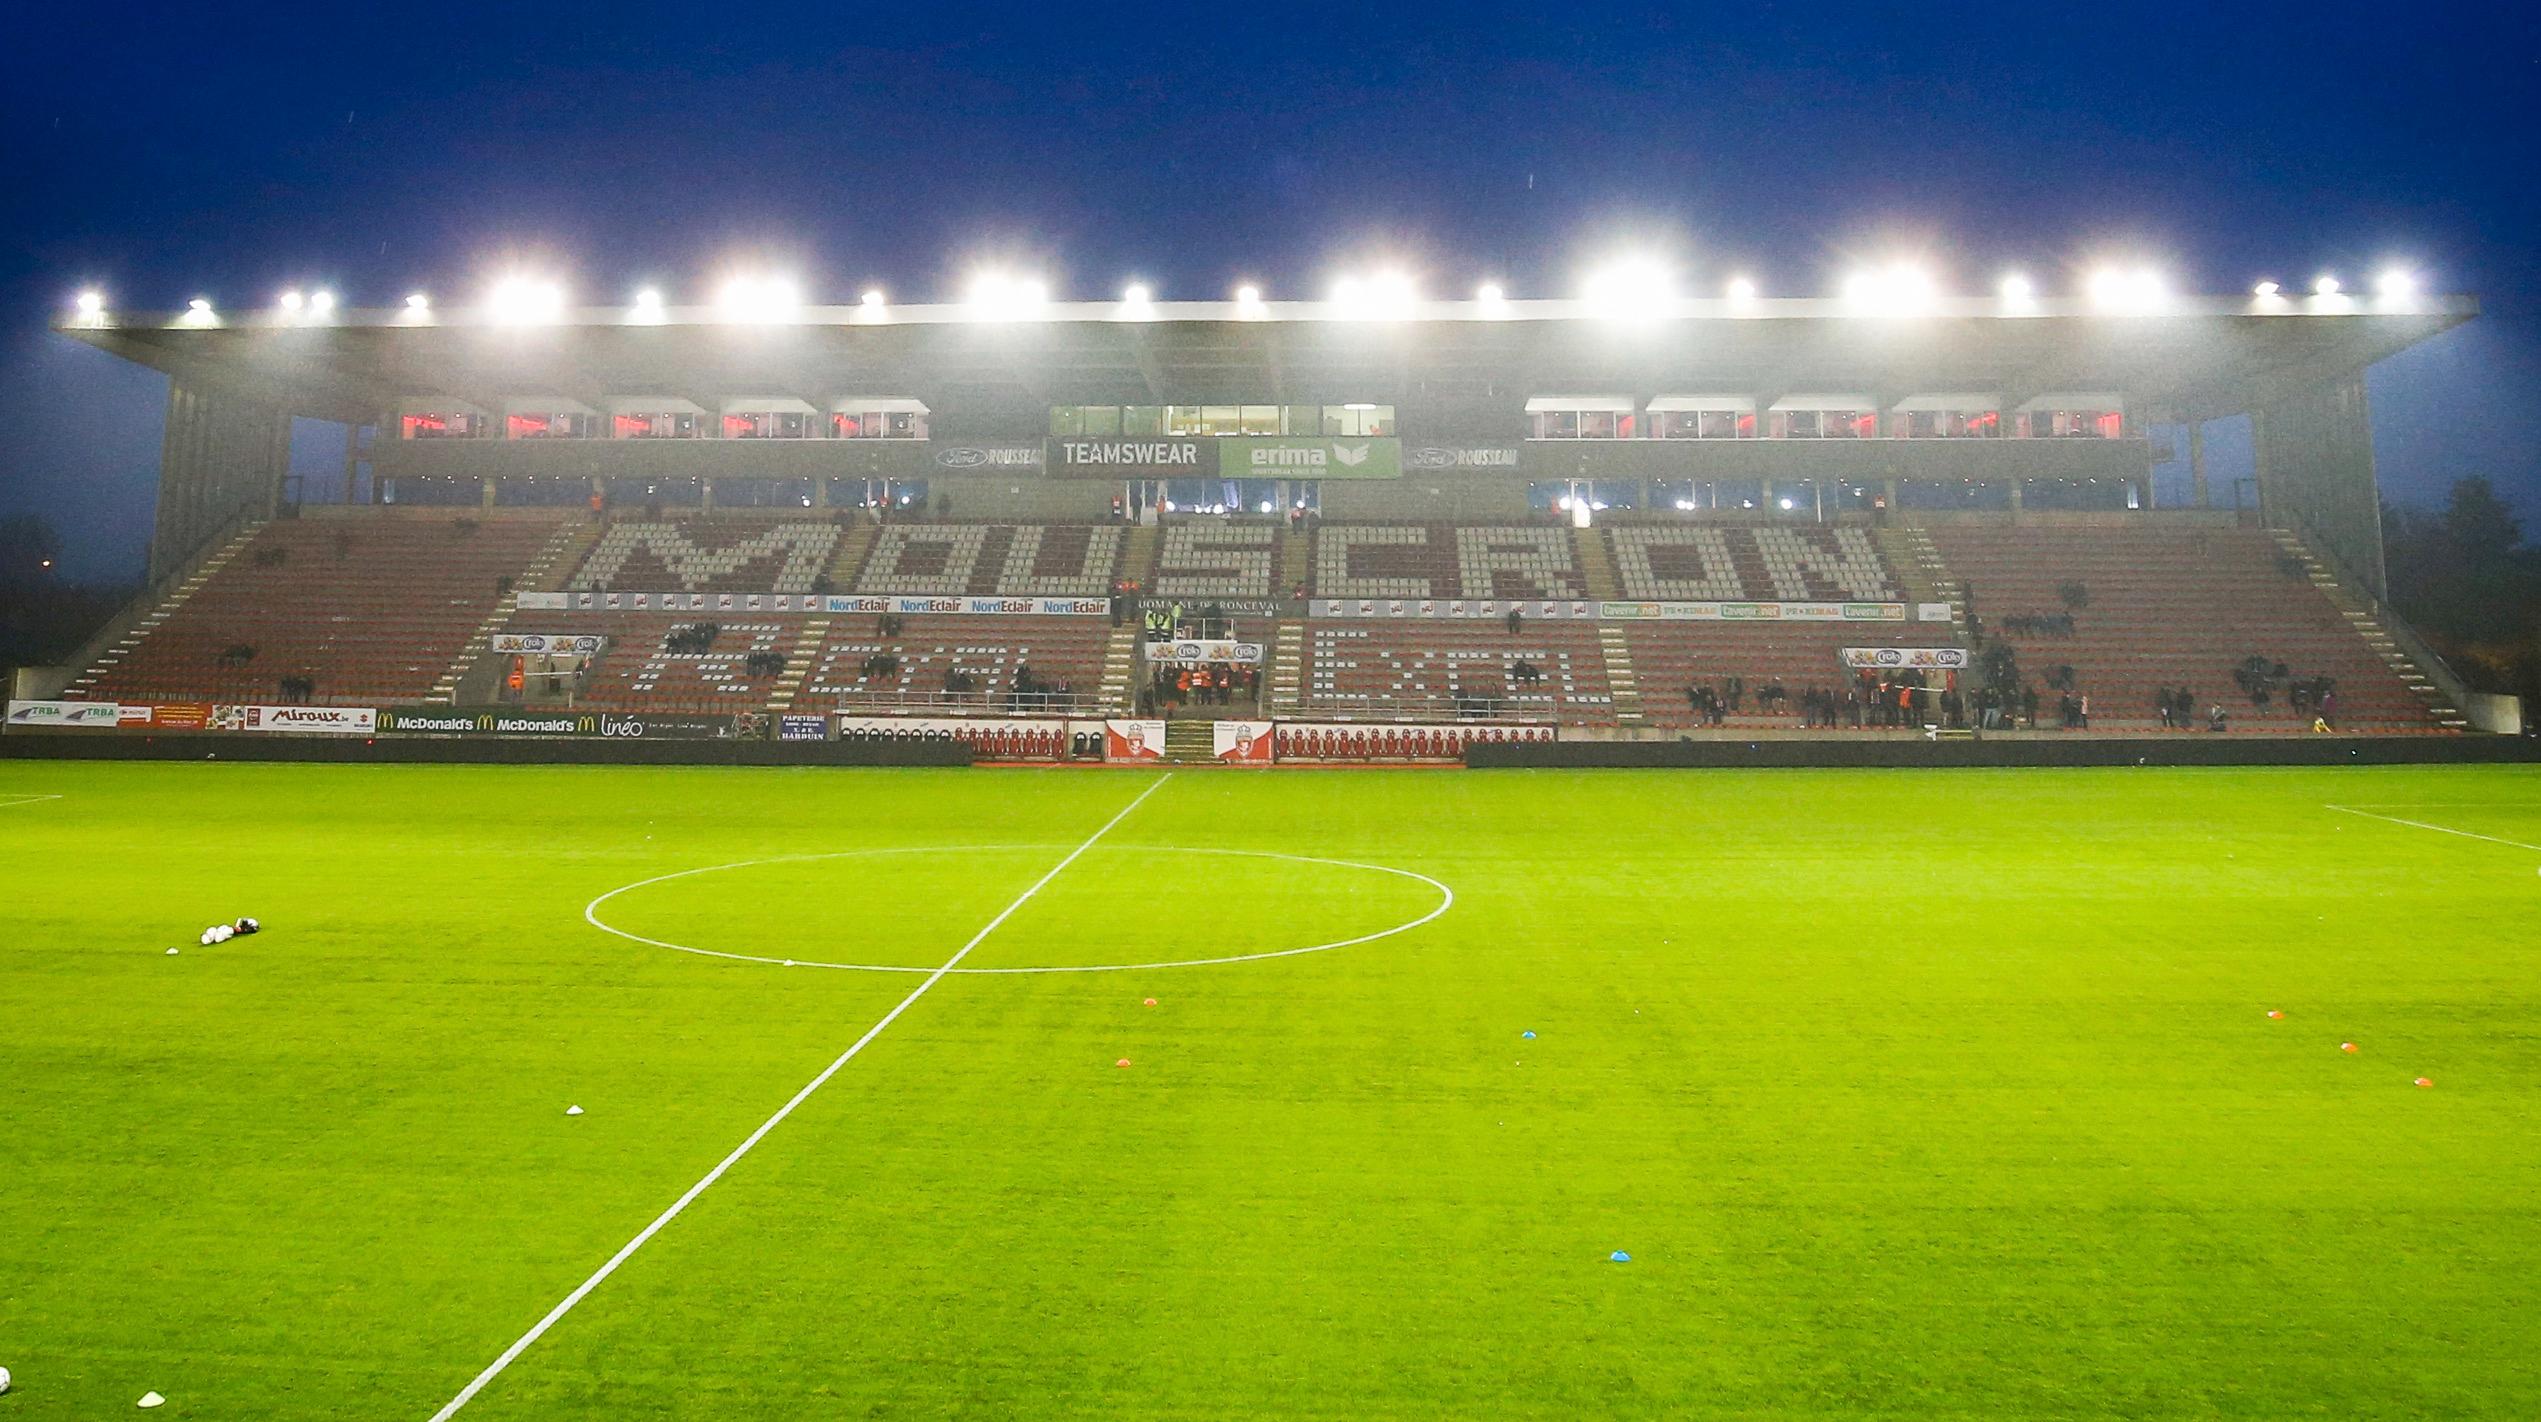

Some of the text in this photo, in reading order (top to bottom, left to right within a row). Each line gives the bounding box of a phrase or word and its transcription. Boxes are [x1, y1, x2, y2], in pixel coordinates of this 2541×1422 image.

[987, 448, 1041, 465] ROUSSEA
[1063, 442, 1197, 465] TEAMSWEAR
[1251, 445, 1328, 466] erima
[1457, 448, 1518, 466] ROUSSEAU
[568, 522, 1897, 600] MOUSCRON
[1138, 600, 1194, 610] DOMANE
[1219, 600, 1282, 611] RONCEVAL
[32, 707, 60, 715] TRBA
[86, 708, 114, 716] TRBA
[397, 717, 474, 731] McDonald's
[497, 719, 575, 732] McDonald's
